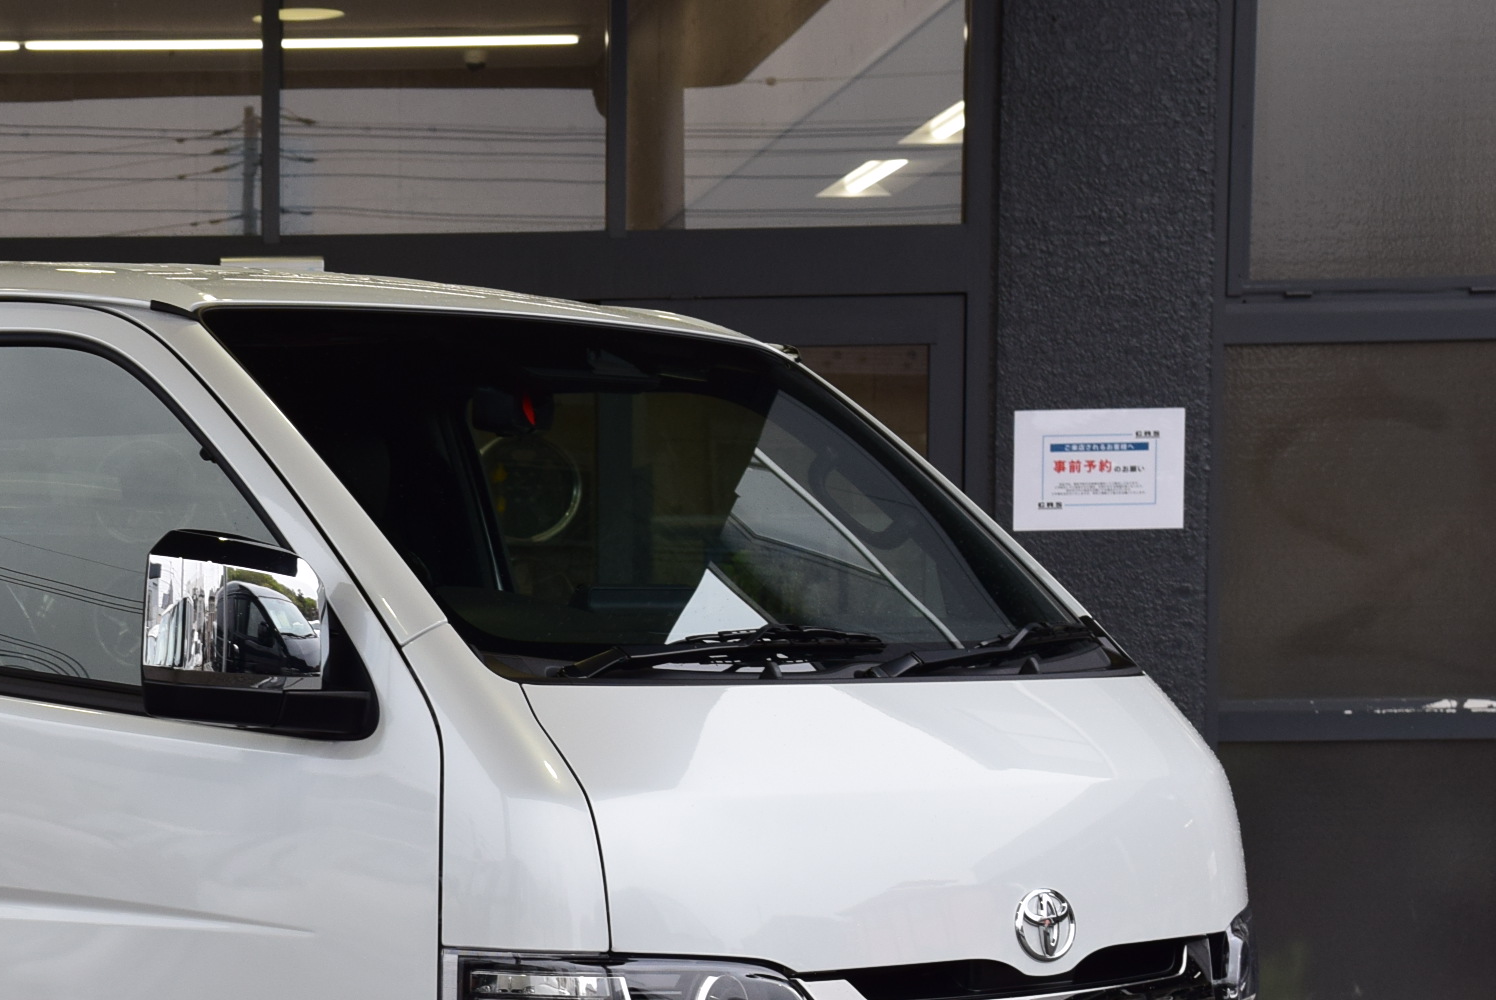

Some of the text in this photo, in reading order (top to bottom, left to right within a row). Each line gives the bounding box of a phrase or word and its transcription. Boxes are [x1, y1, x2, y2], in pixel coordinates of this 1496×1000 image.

[1053, 459, 1145, 474] 事前予約のお願い
